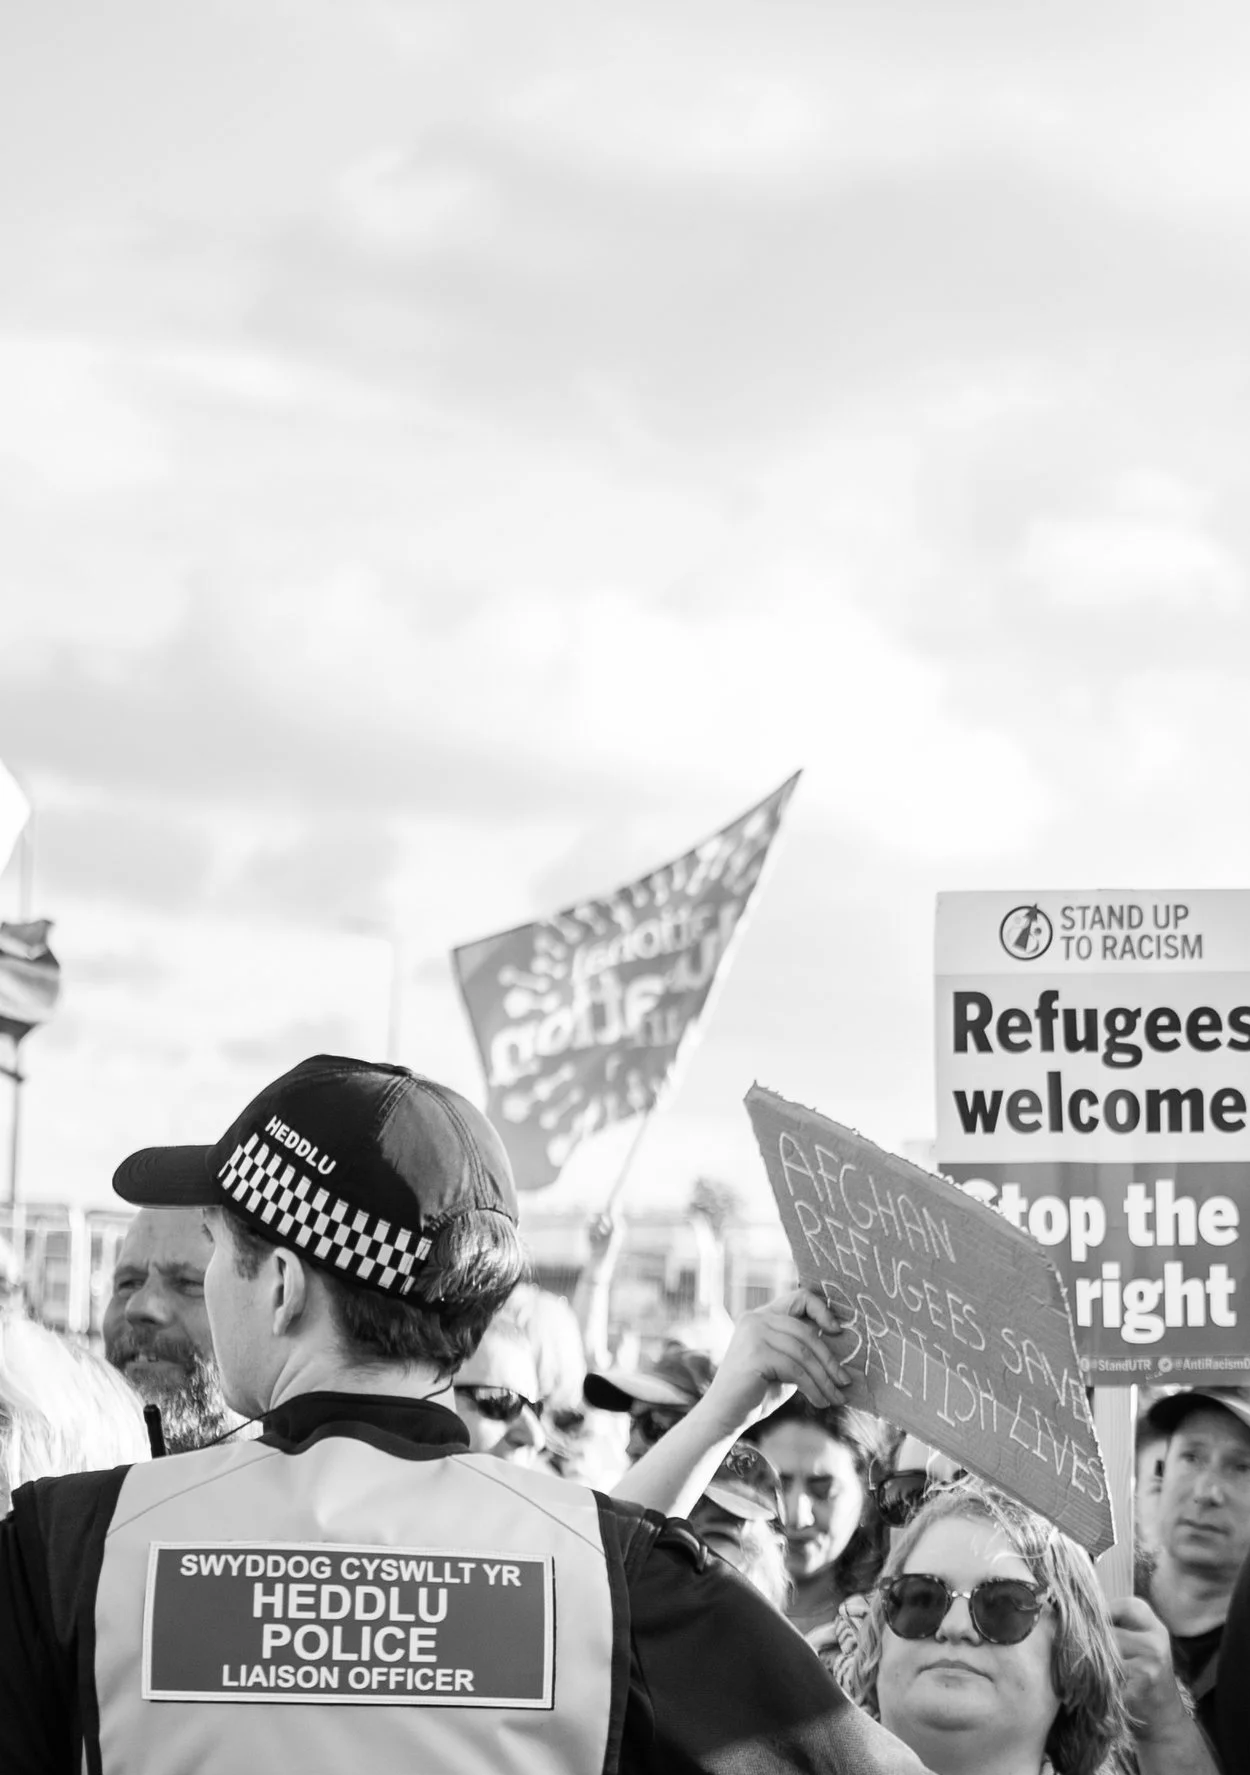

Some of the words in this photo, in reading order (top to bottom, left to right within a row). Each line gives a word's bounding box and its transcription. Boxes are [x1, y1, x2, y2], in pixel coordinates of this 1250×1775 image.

[1060, 905, 1144, 930] STAND
[1153, 904, 1189, 929] UP
[1060, 935, 1093, 960] TO
[1102, 934, 1203, 960] RACISM
[952, 1071, 1247, 1134] welcome
[264, 1115, 337, 1175] HEDDLU
[779, 1131, 956, 1263] AFGHAN
[1124, 1180, 1239, 1247] the
[795, 1200, 985, 1351] REFUGEES
[1076, 1261, 1237, 1343] right
[818, 1279, 997, 1432] BRITISH
[1009, 1395, 1104, 1503] LIVES
[180, 1554, 332, 1579] SWYDDOG
[340, 1559, 475, 1585] CYSWLLT
[483, 1565, 522, 1586] YR
[253, 1583, 448, 1623] HEDDLU
[262, 1624, 437, 1662] POLICE
[222, 1665, 339, 1689] LIAISON
[348, 1667, 474, 1691] OFFICER
